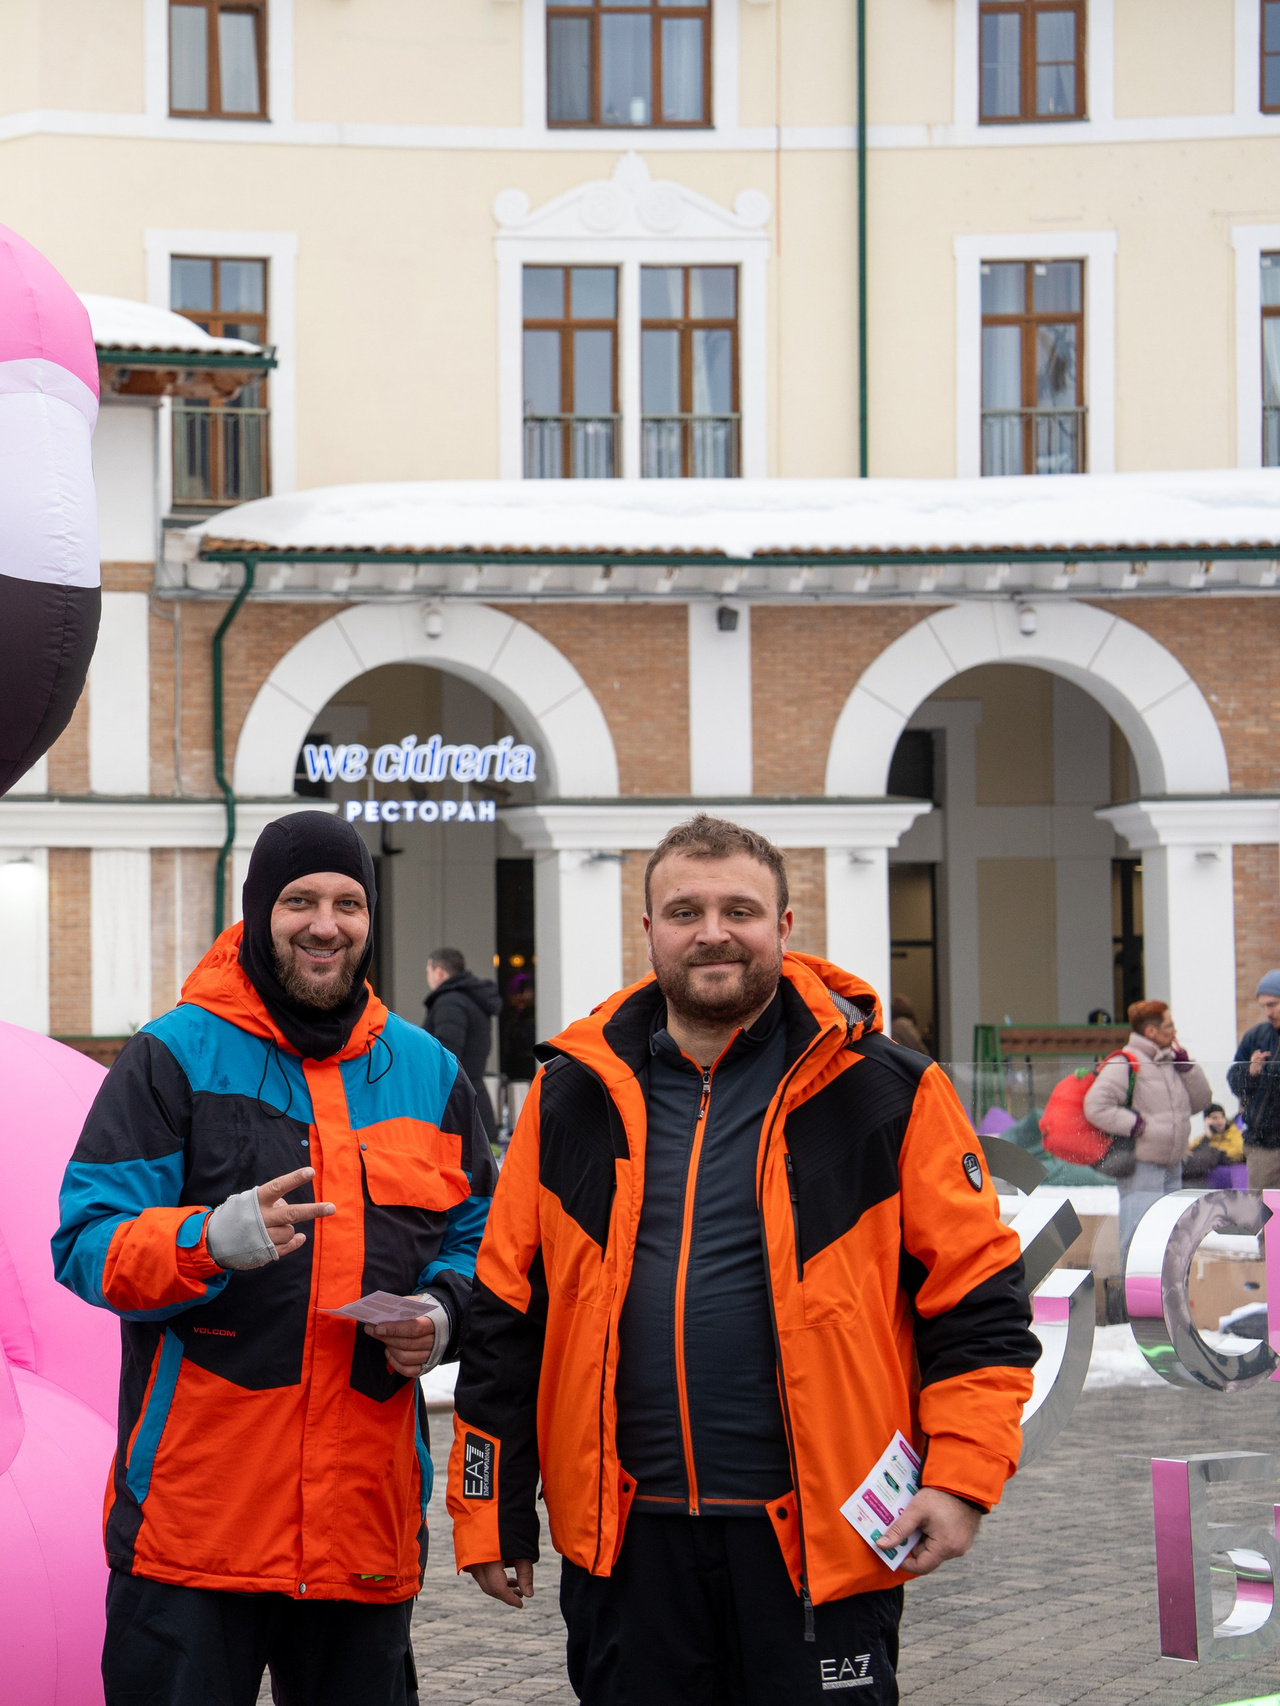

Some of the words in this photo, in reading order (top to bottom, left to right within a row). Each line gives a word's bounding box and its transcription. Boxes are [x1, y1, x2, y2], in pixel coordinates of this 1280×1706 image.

[304, 744, 368, 782] we
[346, 800, 496, 822] РЕСТОРАН
[193, 1326, 236, 1338] VOLCOM
[465, 1443, 484, 1496] EA7
[820, 1653, 871, 1681] EA7
